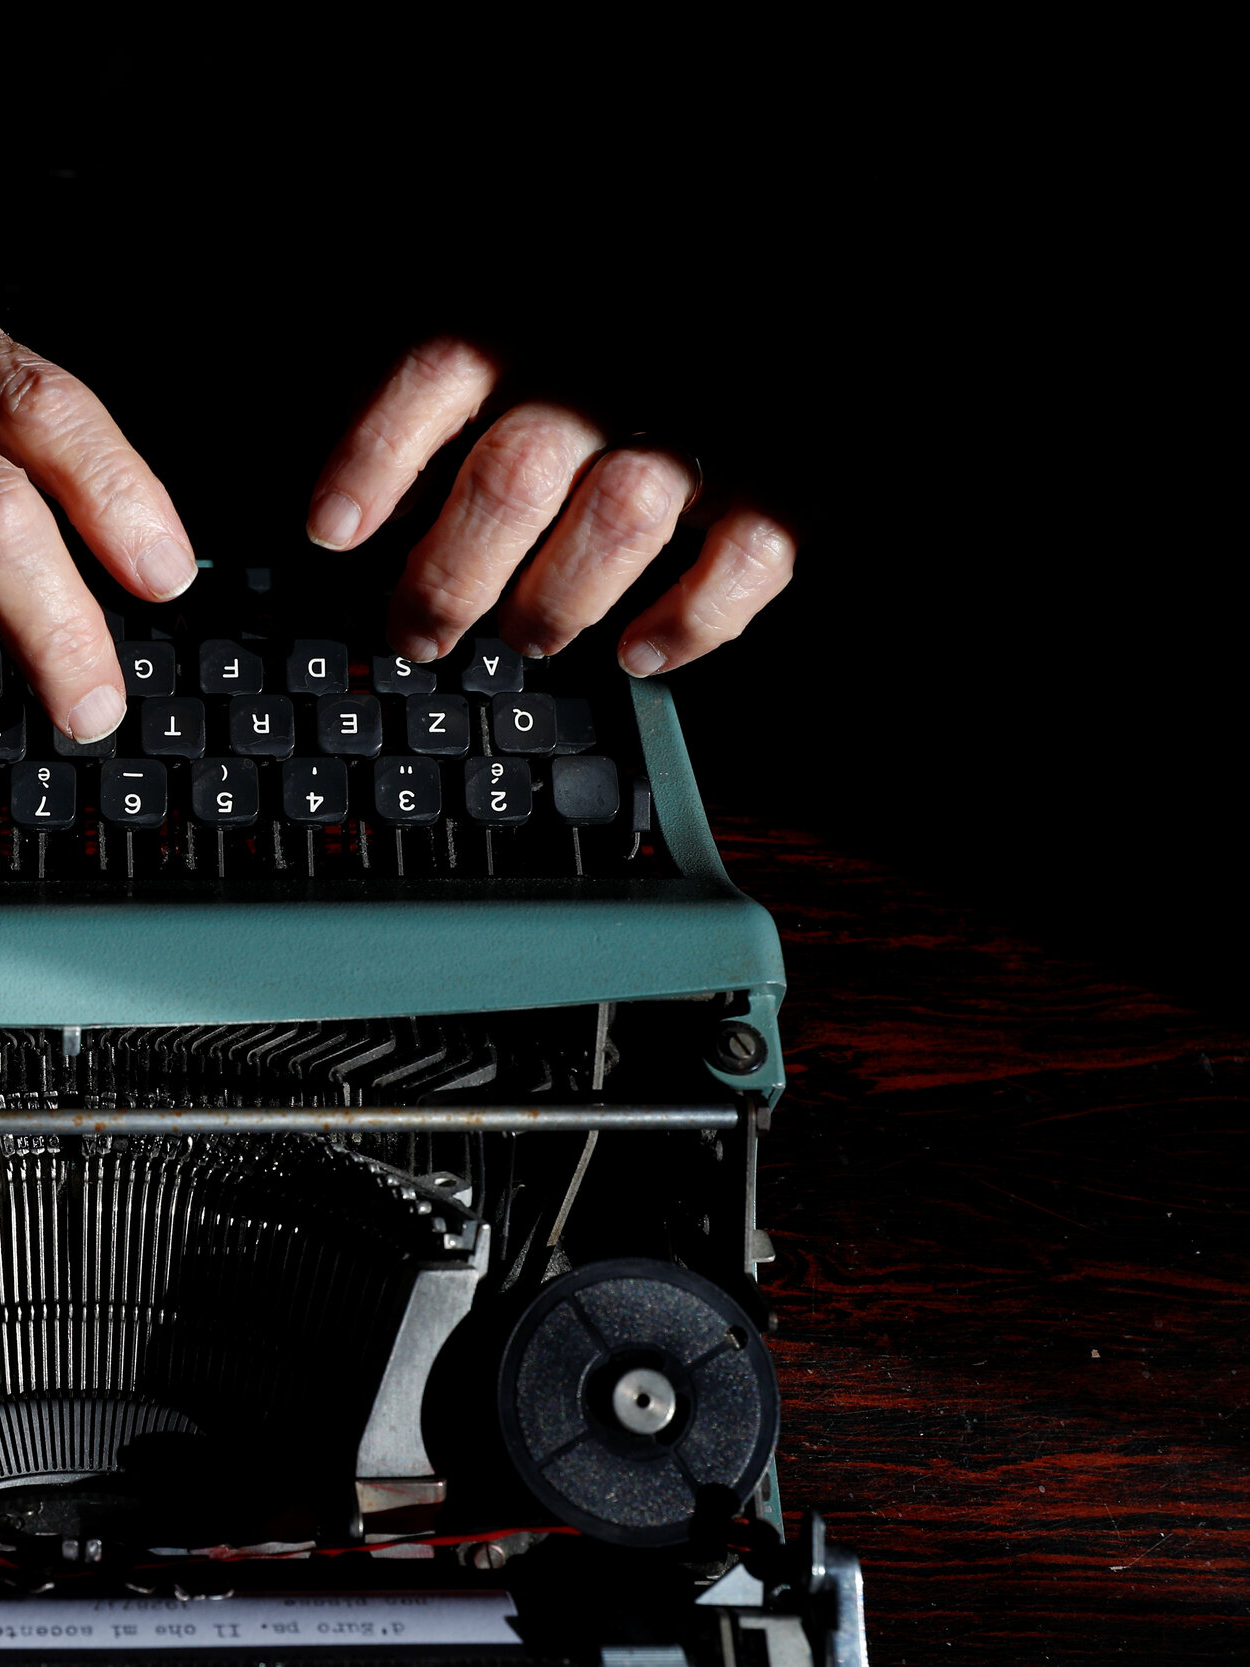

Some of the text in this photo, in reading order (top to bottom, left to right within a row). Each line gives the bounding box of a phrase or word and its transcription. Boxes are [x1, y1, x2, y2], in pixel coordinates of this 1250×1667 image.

[134, 659, 154, 679] G
[222, 658, 239, 679] F
[307, 658, 326, 678] D
[394, 656, 412, 677] S
[482, 656, 500, 676] A
[163, 715, 182, 736] T
[252, 713, 270, 734] R
[339, 713, 358, 734] E
[428, 712, 446, 733] Z
[512, 708, 534, 732] Q
[37, 767, 51, 789] è
[491, 762, 504, 785] é
[34, 795, 51, 817] 7
[124, 793, 142, 815] 6
[216, 791, 233, 813] 5
[305, 791, 324, 813] 4
[398, 790, 416, 812] 3
[490, 791, 508, 812] 2
[110, 1625, 138, 1639] mi
